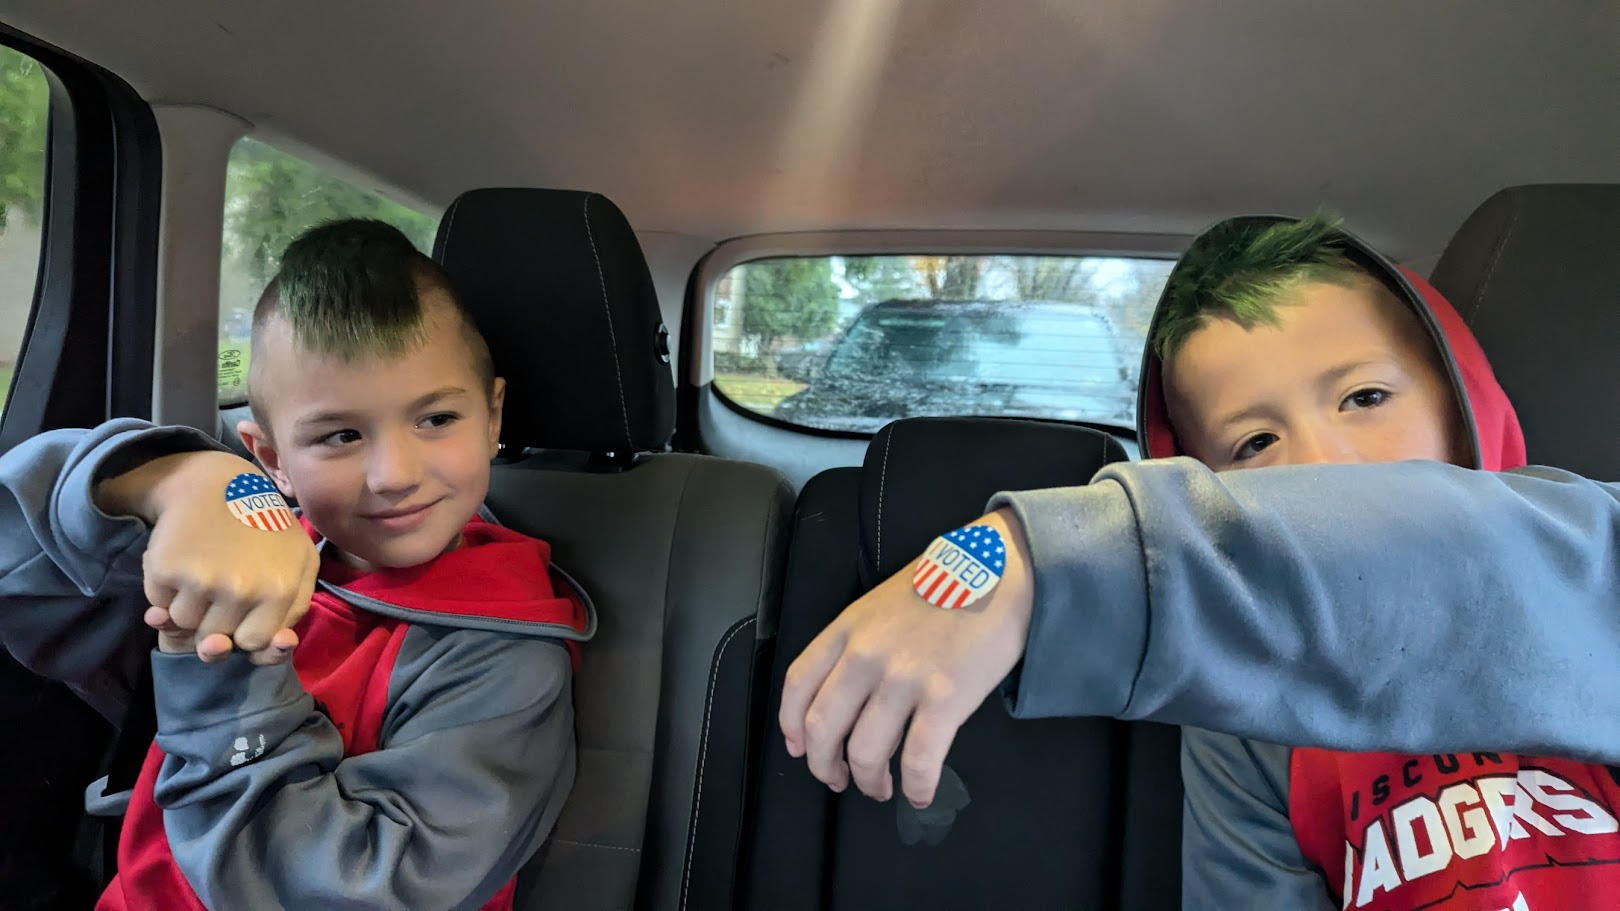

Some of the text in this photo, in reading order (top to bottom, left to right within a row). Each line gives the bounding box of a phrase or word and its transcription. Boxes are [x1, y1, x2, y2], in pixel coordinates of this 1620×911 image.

[233, 493, 285, 515] I VOTED
[929, 539, 990, 589] I VOTED
